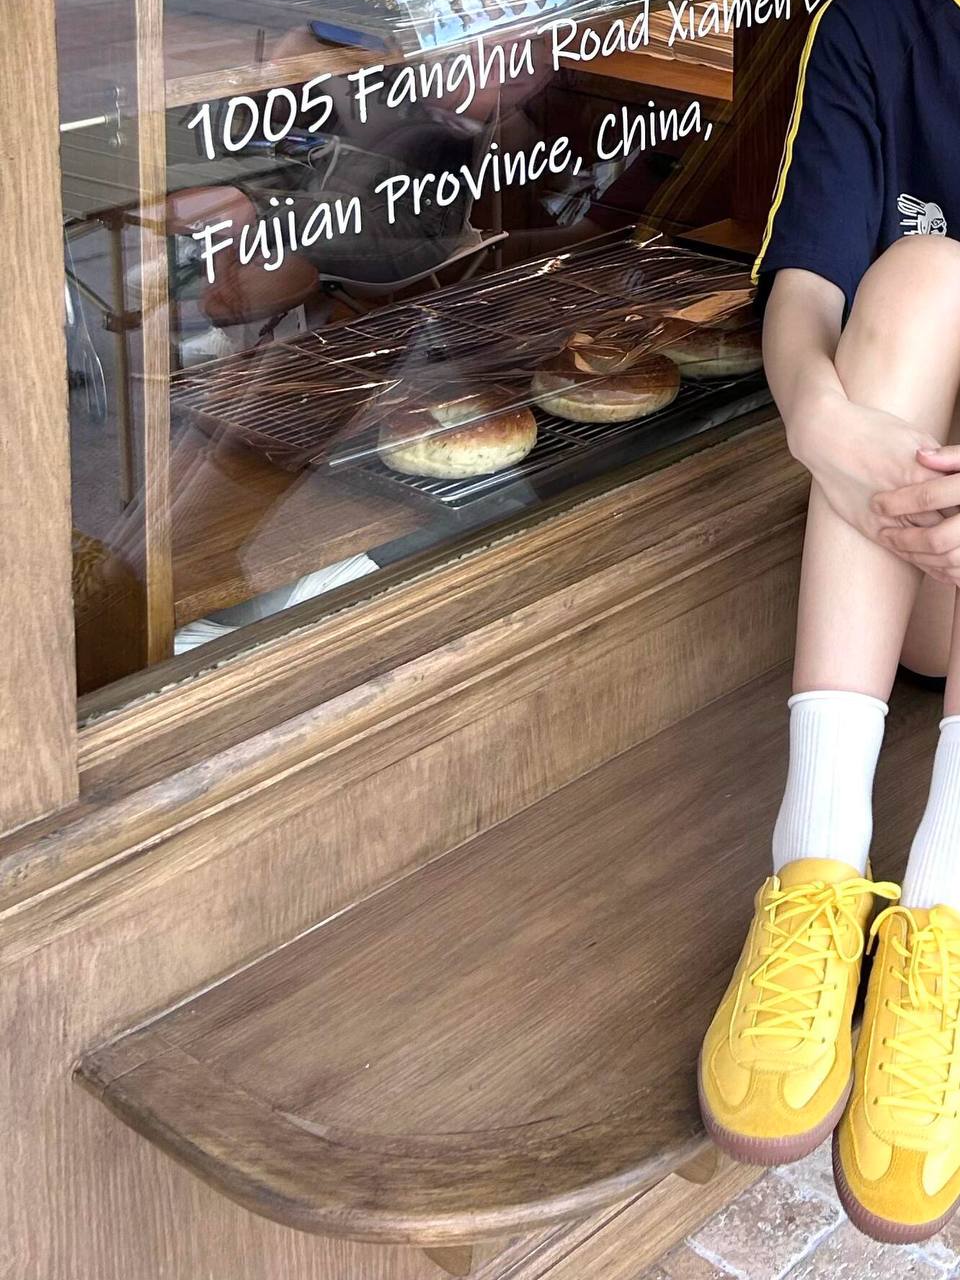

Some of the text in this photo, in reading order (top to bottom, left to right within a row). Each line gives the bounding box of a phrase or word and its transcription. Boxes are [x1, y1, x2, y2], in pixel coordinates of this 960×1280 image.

[187, 73, 334, 160] 1005
[347, 35, 534, 123] Fanghu
[192, 100, 714, 284] Fujian Province, China,
